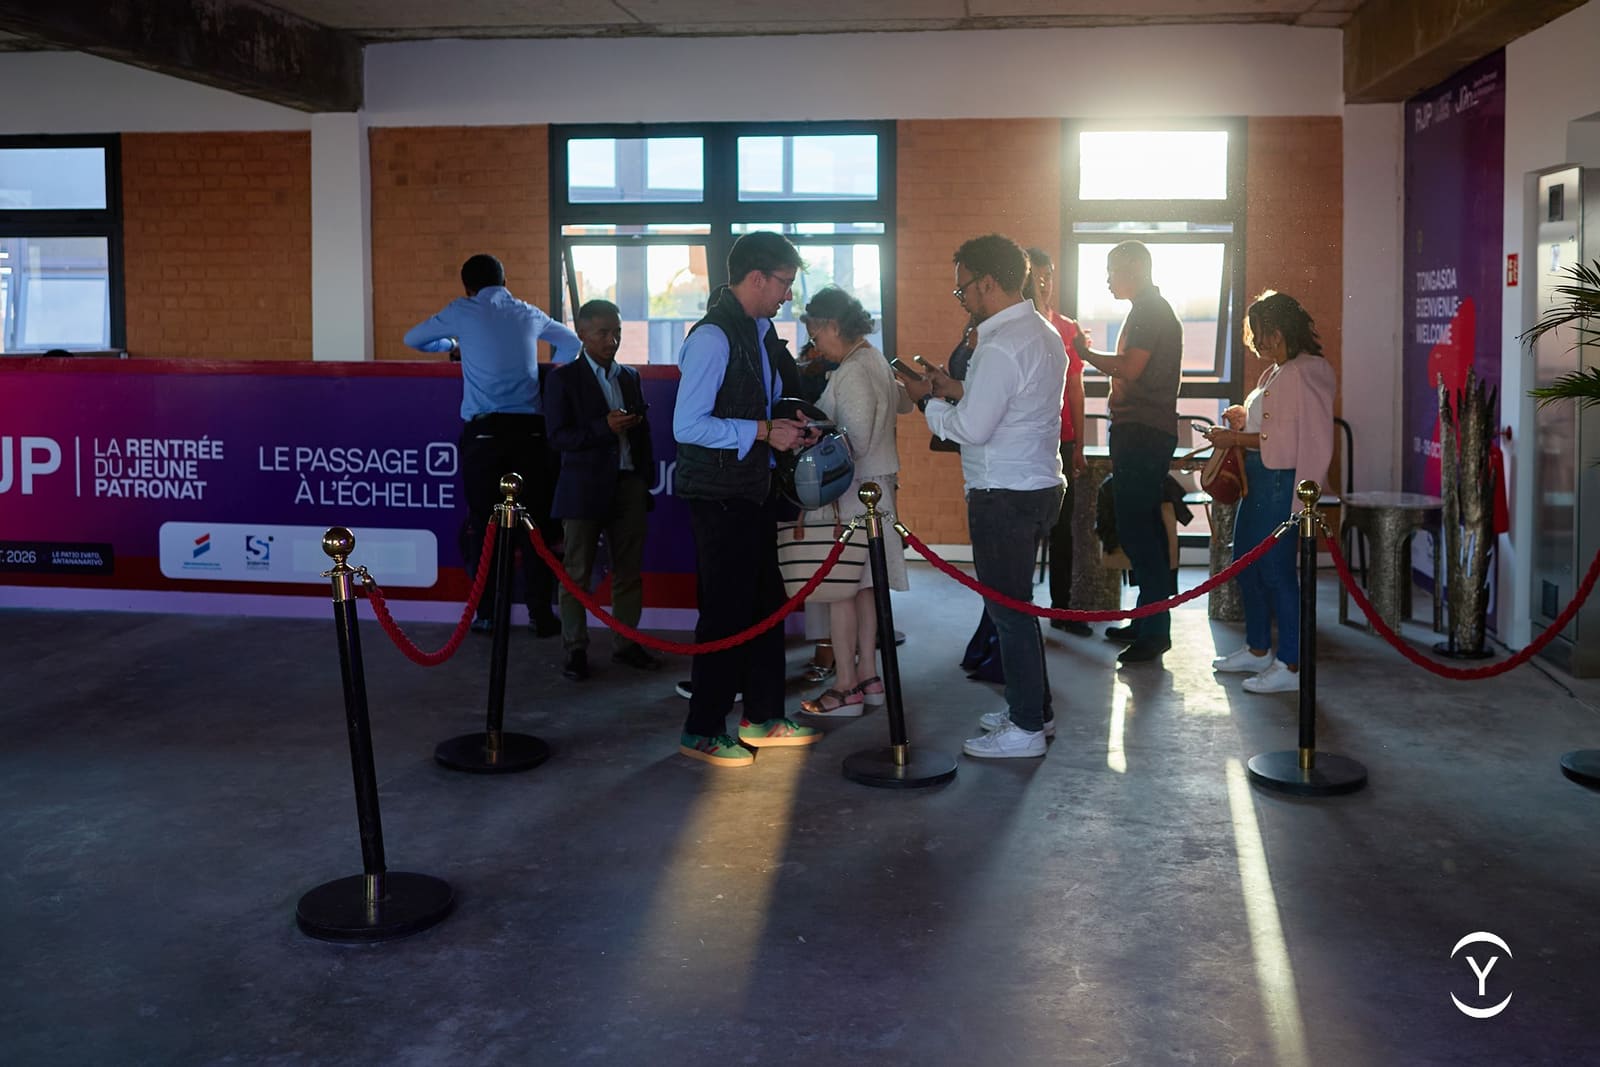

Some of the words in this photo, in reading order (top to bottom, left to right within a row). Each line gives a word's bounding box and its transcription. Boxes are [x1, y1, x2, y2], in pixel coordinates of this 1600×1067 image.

[1416, 323, 1452, 345] WELCOME
[94, 438, 121, 457] LA
[126, 434, 224, 459] RENTRÉE
[95, 459, 123, 478] DU
[128, 459, 198, 479] JEUNE
[259, 446, 290, 471] LE
[296, 447, 418, 474] PASSAGE
[95, 478, 207, 500] PATRONAT
[294, 473, 314, 505] À
[320, 474, 455, 508] L’ÉCHELLE
[7, 550, 37, 563] 2026
[52, 551, 59, 559] LE
[61, 551, 79, 559] PATIO
